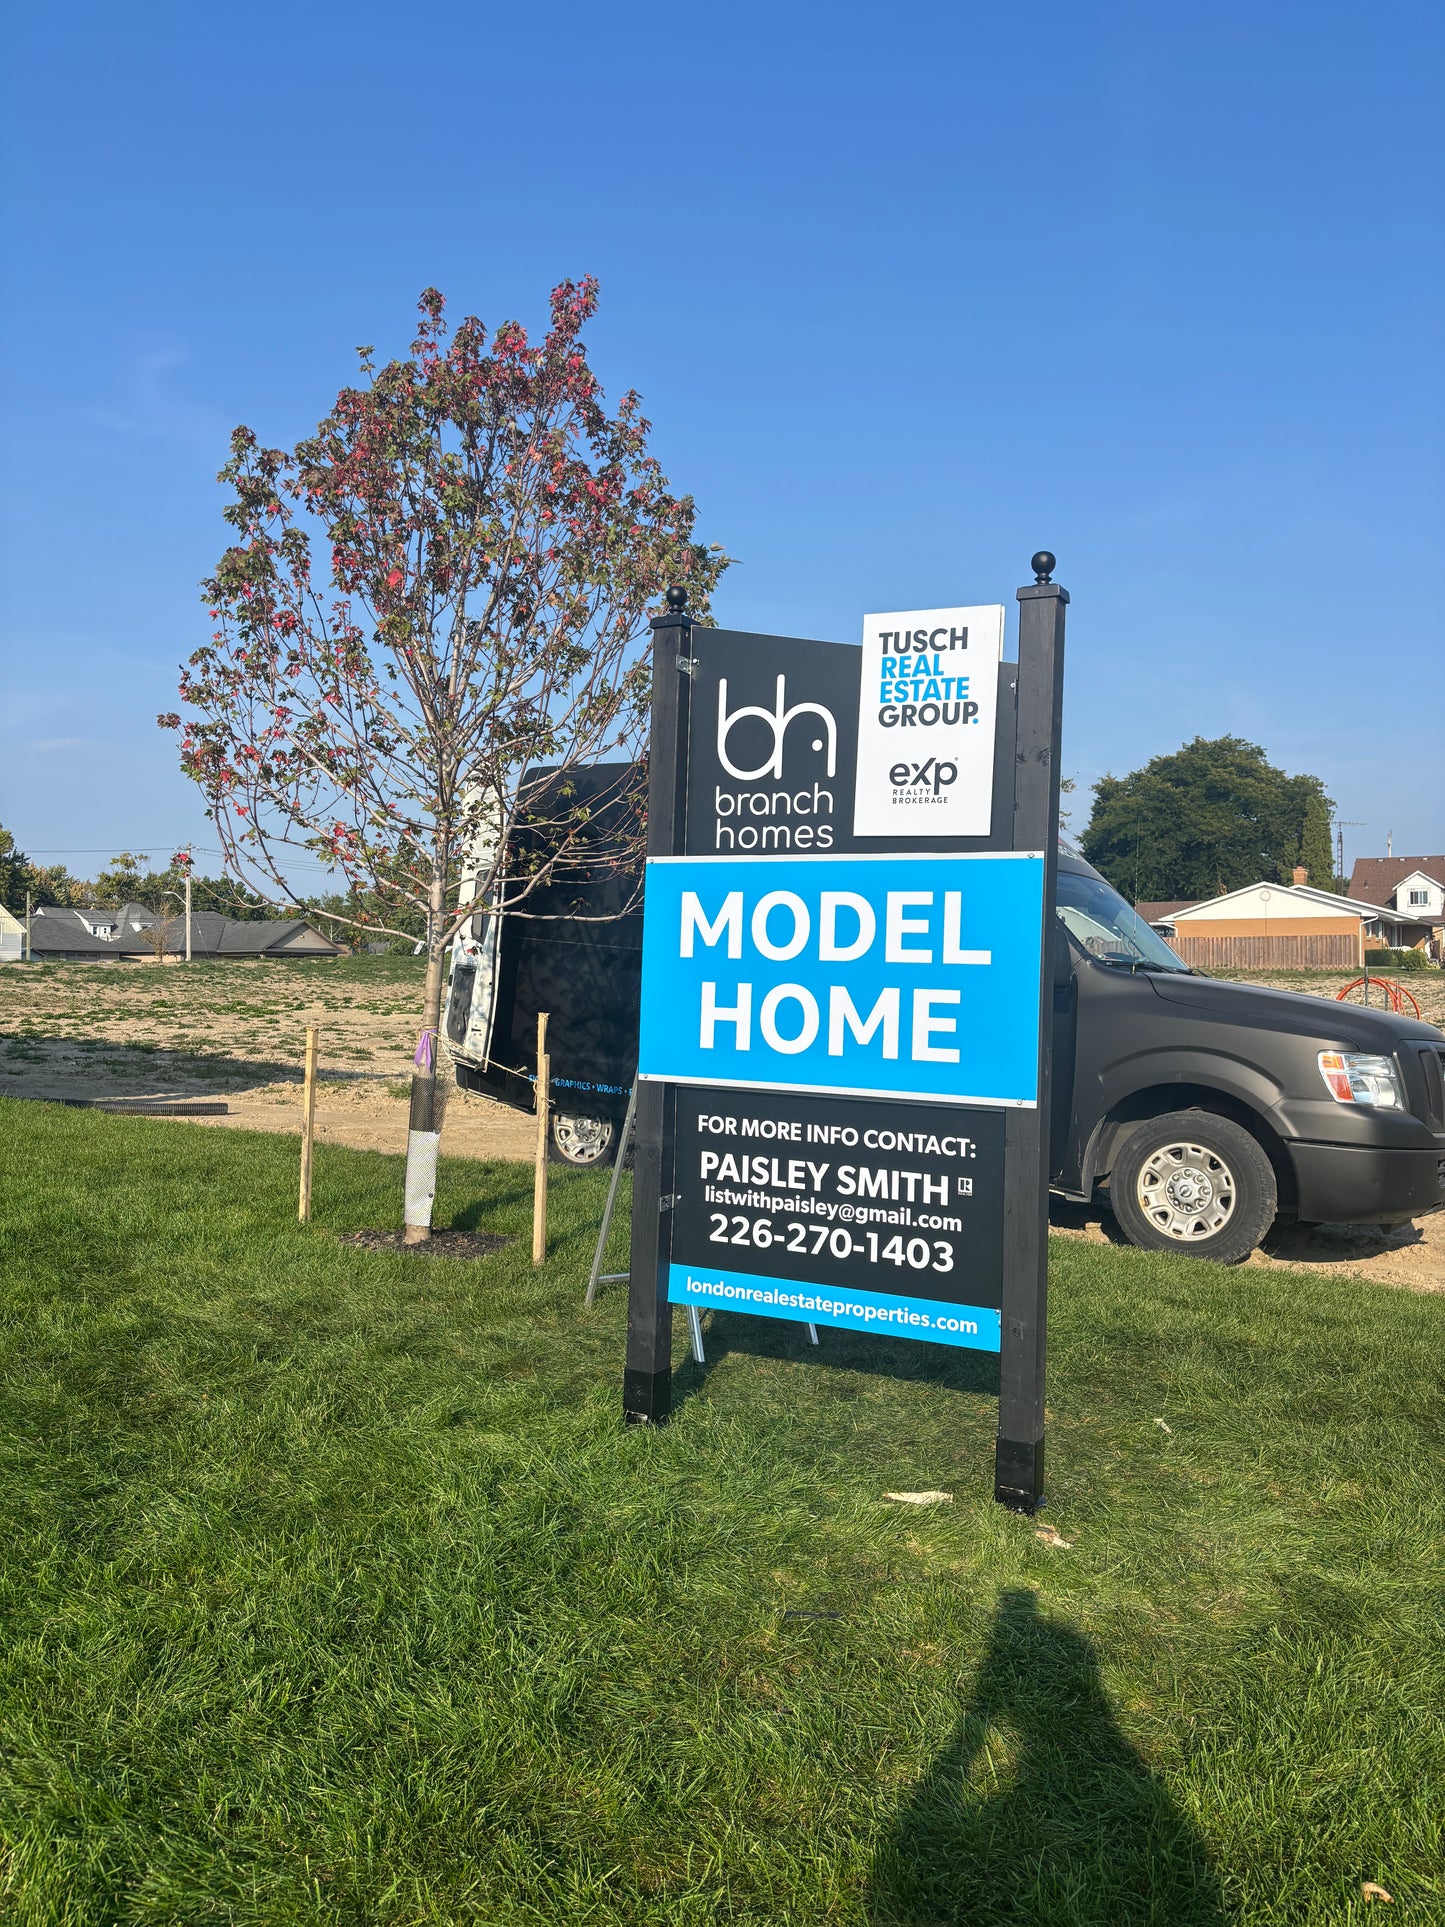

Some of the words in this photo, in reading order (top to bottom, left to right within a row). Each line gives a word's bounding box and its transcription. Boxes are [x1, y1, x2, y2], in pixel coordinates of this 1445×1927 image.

[878, 626, 969, 655] TUSCH
[880, 654, 945, 679] REAL
[879, 676, 970, 704] ESTATE
[878, 701, 979, 728] GROUP.
[715, 782, 834, 817] branch
[892, 788, 931, 796] REALTY
[892, 796, 948, 804] BROKERAGE
[715, 818, 834, 849] homes
[679, 890, 992, 965] MODEL
[699, 981, 961, 1064] HOME
[555, 1077, 591, 1091] GRAPHICS
[596, 1083, 623, 1095] WRAPS
[698, 1115, 738, 1136] FOR
[741, 1119, 802, 1142] MORE
[806, 1124, 859, 1147] INFO
[863, 1129, 977, 1158] CONTACT:
[700, 1151, 831, 1192] PAISLEY
[837, 1165, 949, 1206] SMITH
[704, 1185, 963, 1232] listwithpaisley@gmail.com
[708, 1213, 955, 1273] 226-270-1403
[686, 1276, 979, 1335] londonrealestateproperties.com
